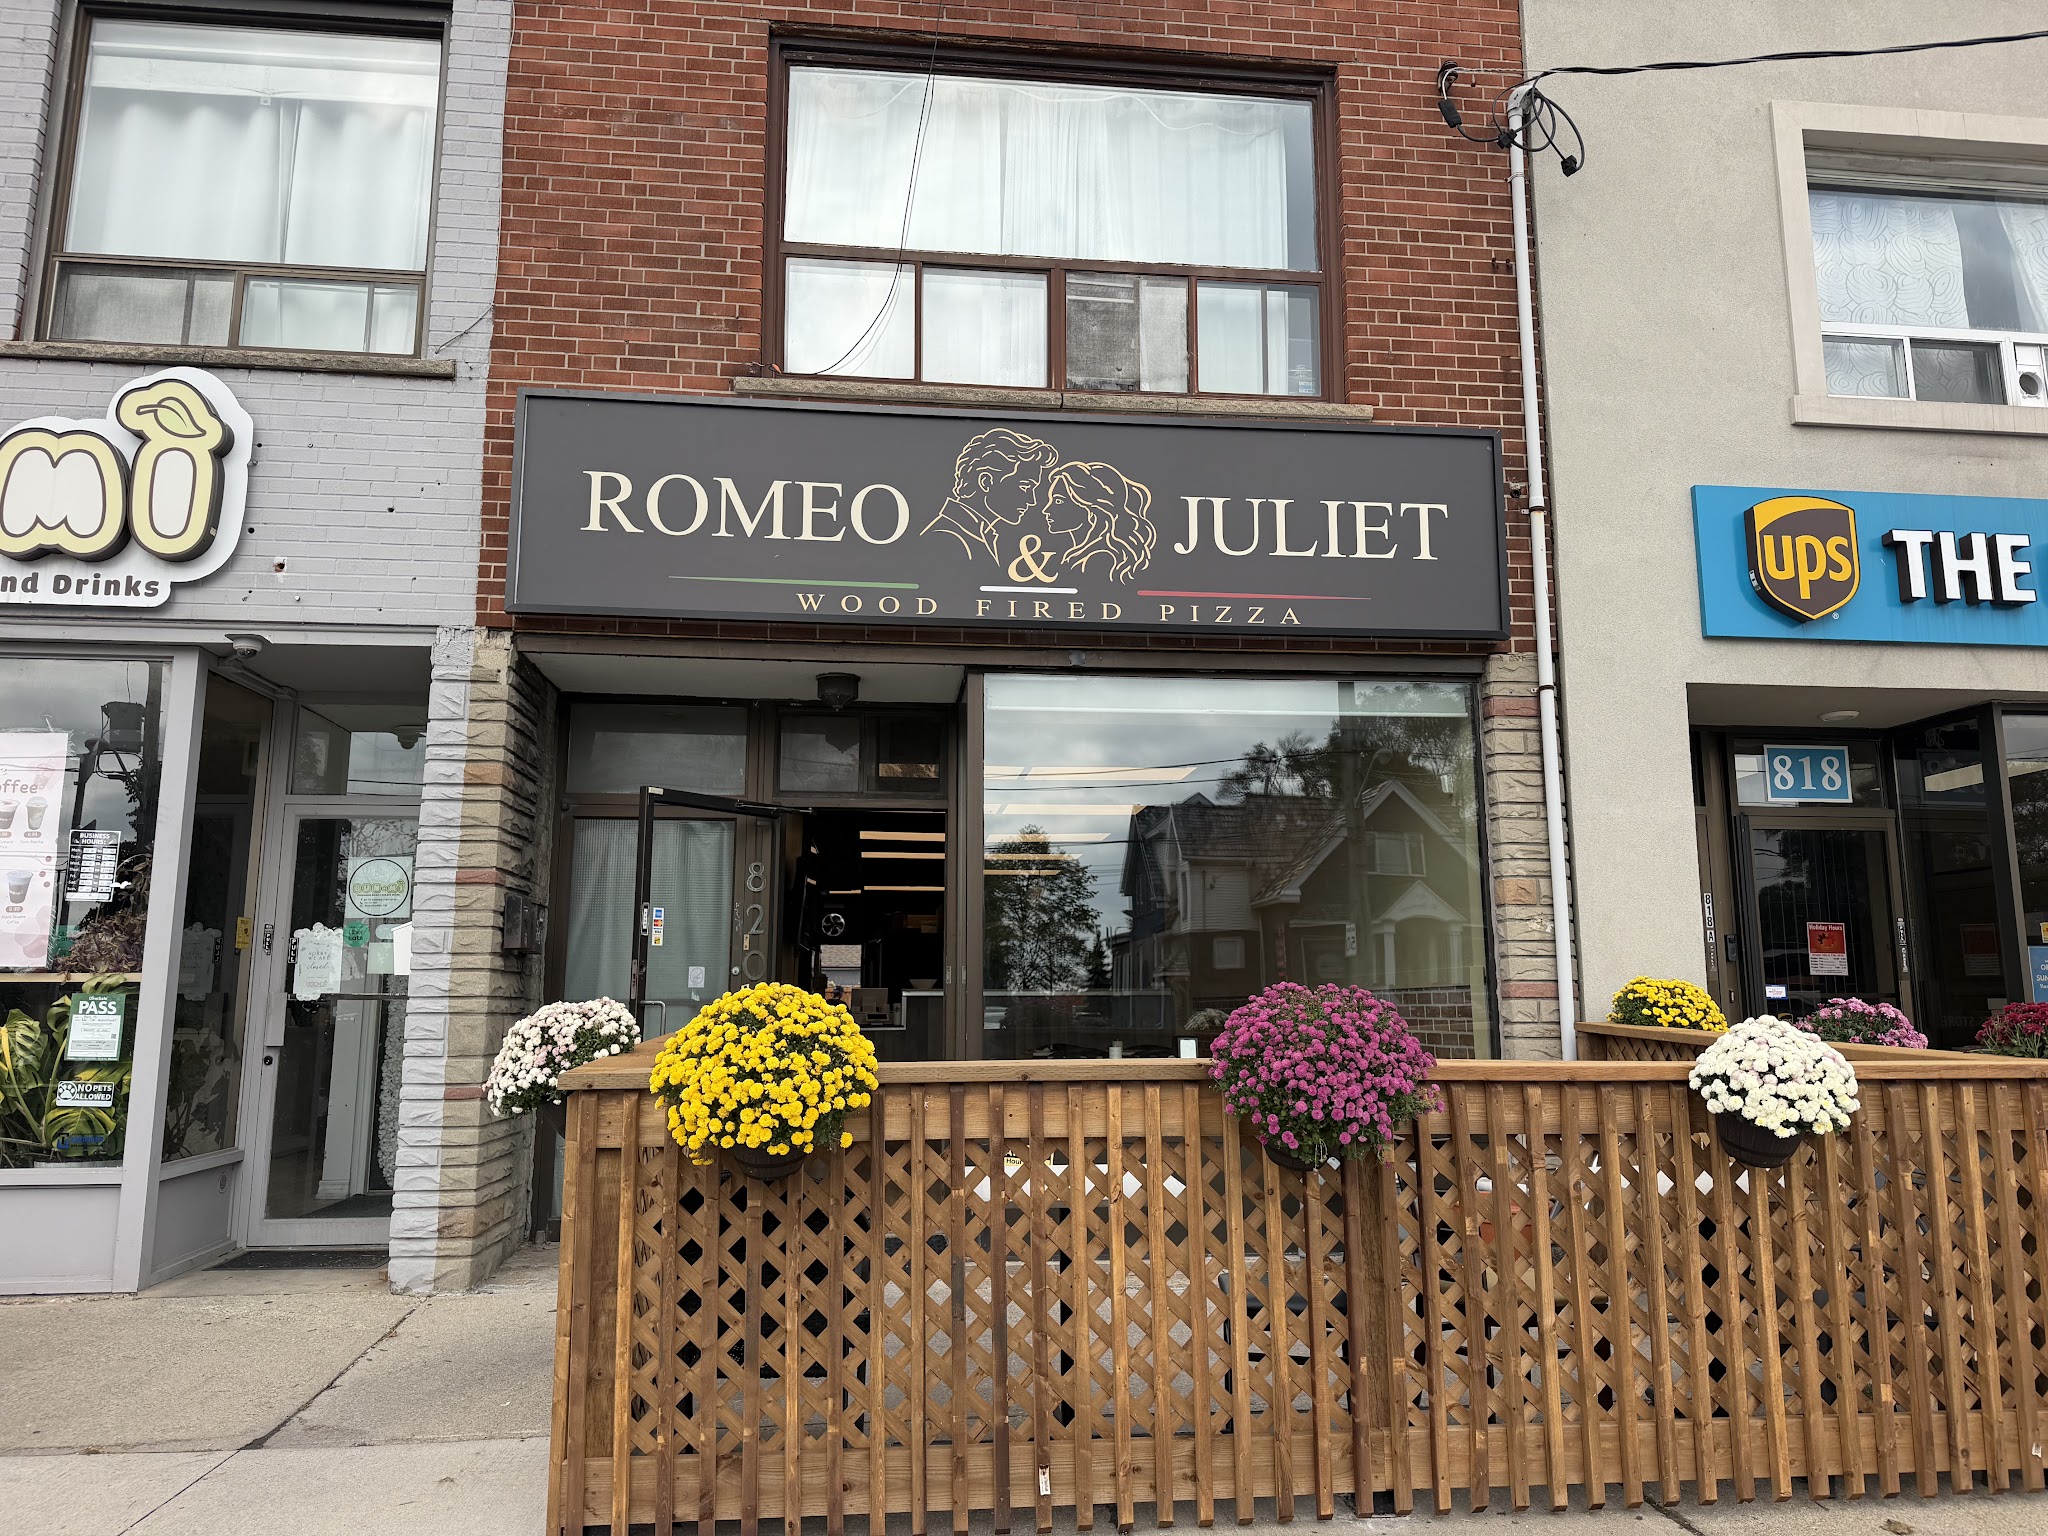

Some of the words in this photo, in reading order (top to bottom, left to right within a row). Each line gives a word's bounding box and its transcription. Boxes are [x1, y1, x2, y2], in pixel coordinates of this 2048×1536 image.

[580, 470, 910, 545] ROMEO
[1008, 534, 1058, 583] &
[1174, 496, 1448, 560] JULIET
[1763, 535, 1852, 599] ups
[1886, 529, 2037, 602] THE
[53, 573, 159, 597] Drinks
[797, 593, 938, 615] WOOD
[976, 599, 1122, 621] FIRED
[1159, 604, 1301, 625] PIZZA
[0, 779, 38, 793] ffee
[1773, 755, 1842, 791] 818
[743, 861, 768, 981] 820
[290, 939, 298, 962] PULL
[78, 1000, 117, 1015] PASS
[75, 1093, 111, 1101] ALLOWED
[77, 1084, 92, 1092] NO
